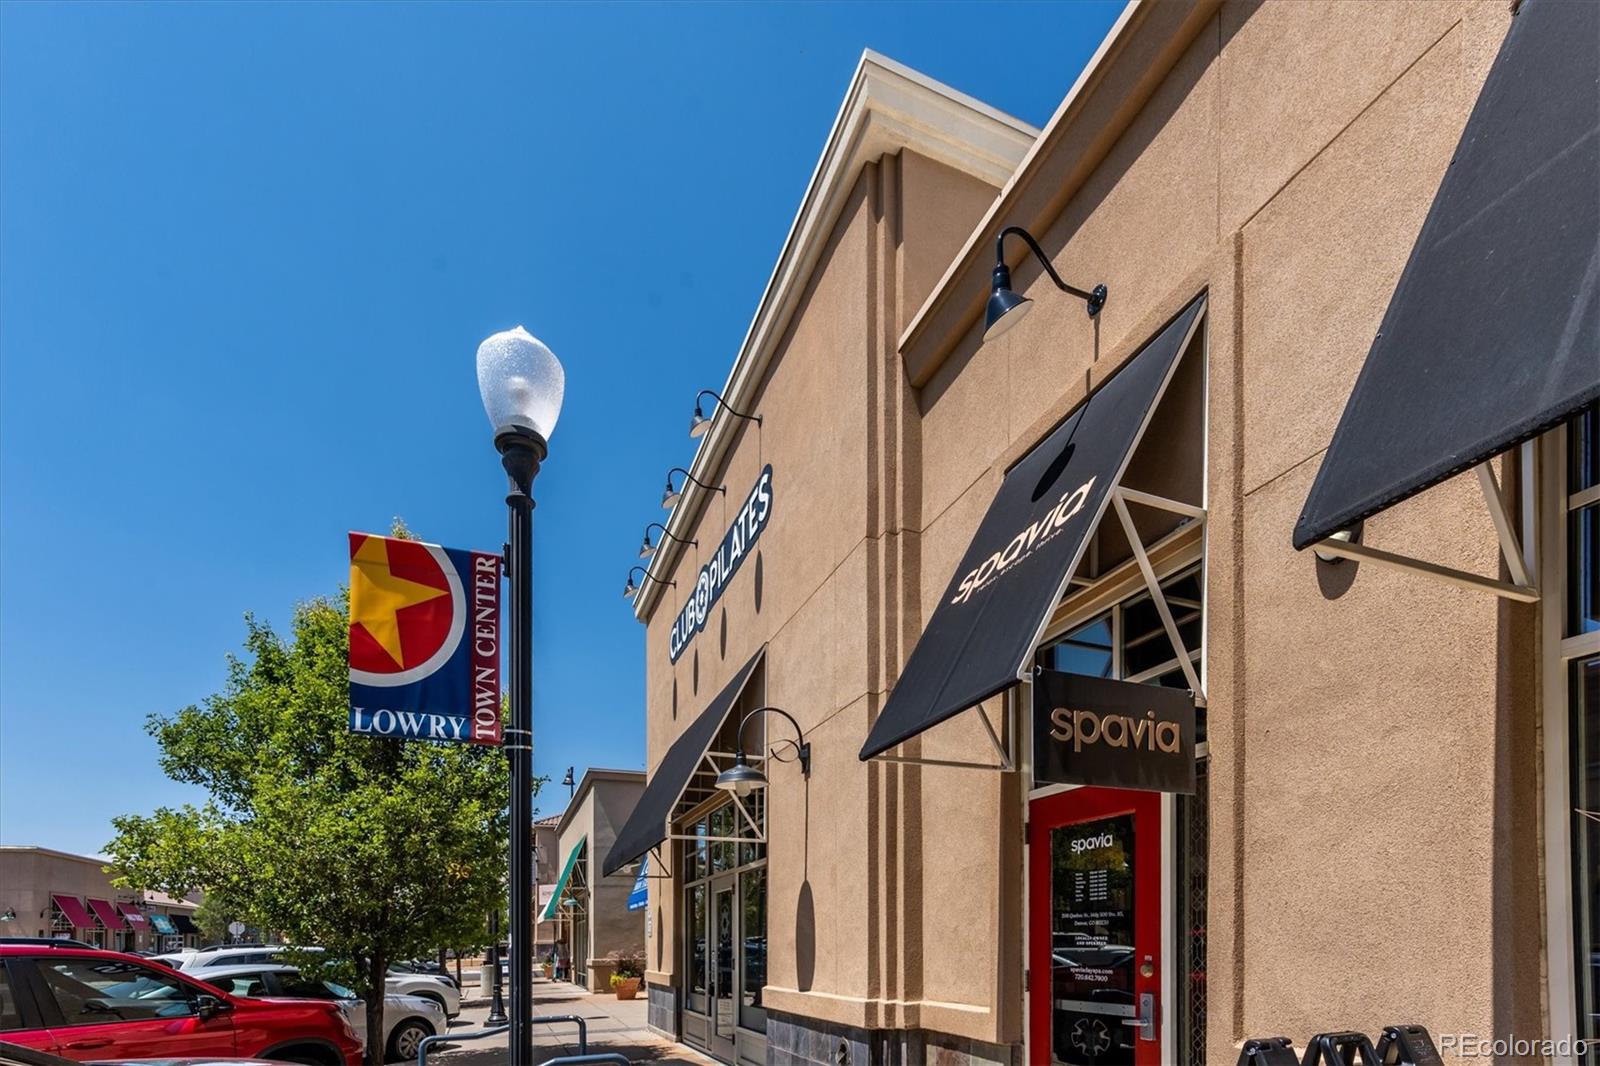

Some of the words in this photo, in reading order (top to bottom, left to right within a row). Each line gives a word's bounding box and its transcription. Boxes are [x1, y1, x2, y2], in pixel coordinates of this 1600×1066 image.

[670, 598, 695, 659] CLUB
[709, 473, 770, 600] PILATES
[951, 475, 1097, 605] spavia
[475, 556, 496, 657] CENTER
[353, 706, 467, 740] LOWRY
[475, 667, 496, 739] TOWN
[1050, 707, 1180, 753] spavia
[1071, 832, 1113, 855] spavia
